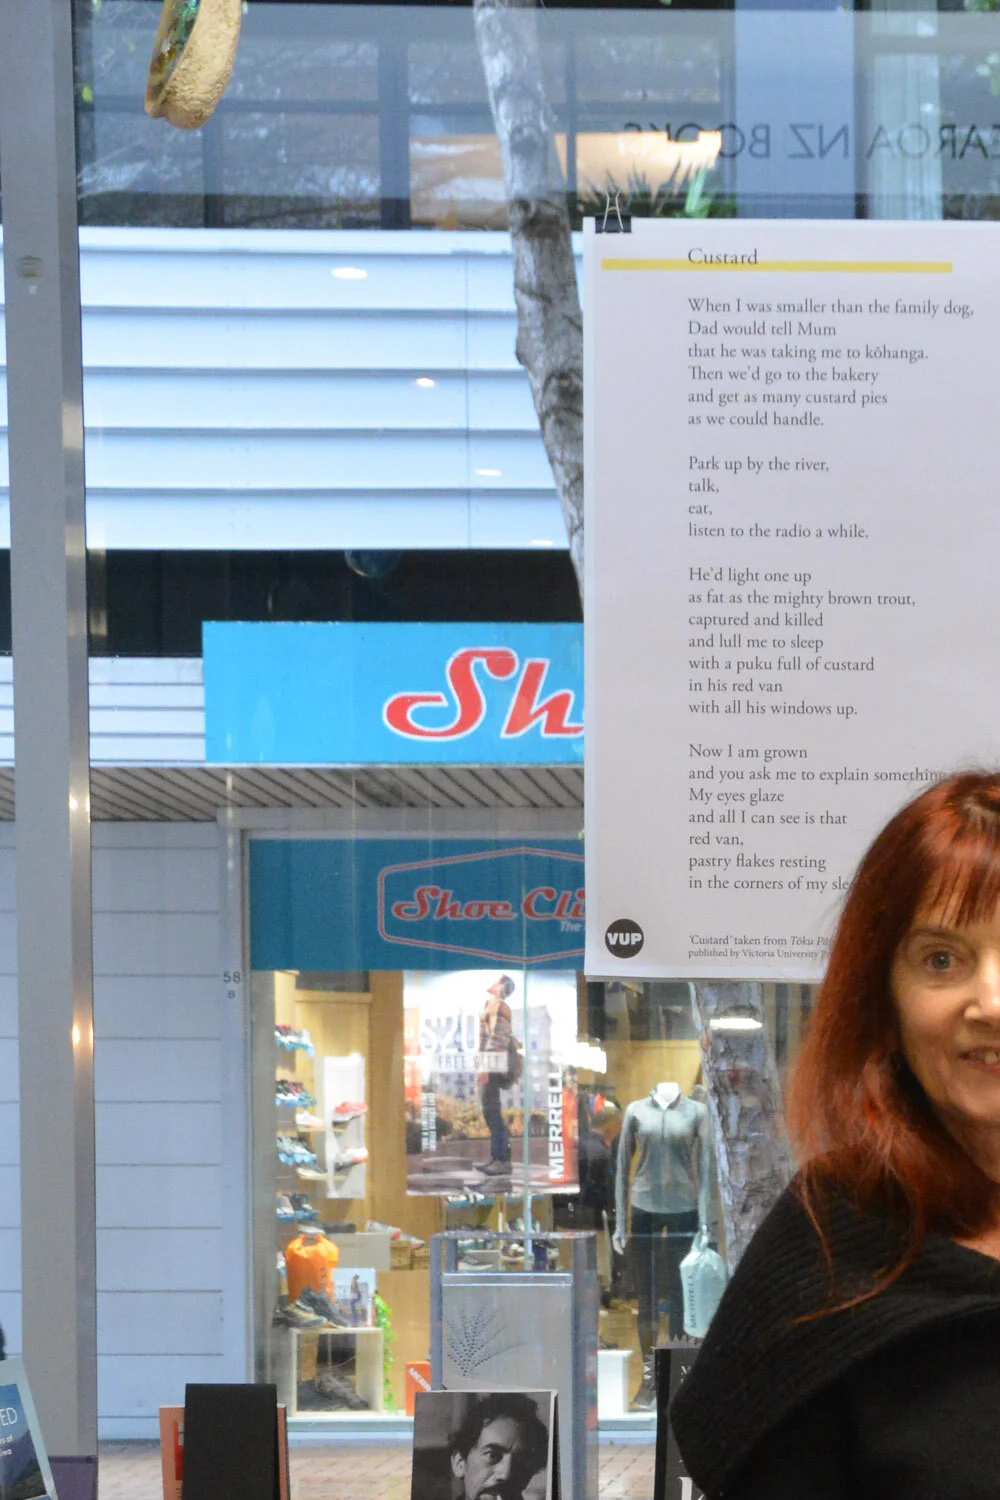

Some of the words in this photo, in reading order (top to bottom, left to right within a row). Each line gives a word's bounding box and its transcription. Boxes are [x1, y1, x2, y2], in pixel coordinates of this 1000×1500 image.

[688, 248, 758, 265] Custard
[687, 297, 731, 313] When
[746, 303, 772, 313] was
[776, 297, 827, 314] smaller
[831, 297, 863, 314] than
[868, 298, 891, 314] the
[895, 298, 940, 319] family
[943, 299, 974, 320] dog,
[688, 319, 718, 336] Dad
[722, 320, 766, 336] would
[771, 320, 793, 336] tell
[797, 321, 837, 337] Mum
[688, 342, 716, 359] that
[720, 343, 737, 358] he
[741, 347, 767, 359] was
[771, 343, 817, 364] taking
[821, 348, 843, 359] me
[846, 348, 861, 359] to
[687, 364, 723, 381] Then
[764, 370, 783, 386] go
[786, 370, 801, 381] to
[805, 366, 828, 381] the
[831, 365, 879, 386] bakery
[687, 387, 714, 403] and
[718, 392, 739, 408] get
[743, 393, 758, 403] as
[762, 393, 802, 408] many
[805, 388, 857, 405] custard
[861, 390, 888, 409] pies
[687, 415, 702, 425] as
[705, 415, 726, 426] we
[729, 410, 769, 426] could
[773, 410, 824, 427] handle.
[688, 455, 720, 471] Park
[724, 460, 743, 475] up
[746, 455, 764, 475] by
[768, 455, 791, 471] the
[795, 457, 830, 473] river,
[688, 477, 720, 494] talk,
[688, 504, 713, 516] eat,
[688, 521, 725, 537] listen
[730, 527, 745, 538] to
[748, 522, 771, 538] the
[775, 522, 812, 538] radio
[815, 528, 823, 538] a
[827, 522, 869, 539] while.
[383, 646, 584, 741] Sh
[688, 743, 723, 758] Now
[737, 748, 760, 759] am
[763, 748, 808, 763] grown
[688, 764, 715, 780] and
[719, 770, 745, 784] you
[748, 765, 772, 780] ask
[775, 770, 797, 781] me
[801, 770, 816, 781] to
[818, 766, 870, 786] explain
[689, 787, 713, 806] My
[716, 792, 746, 806] eyes
[749, 787, 785, 807] glaze
[392, 886, 517, 920] Shoe
[521, 886, 585, 920] Cli
[607, 932, 644, 945] VUP
[734, 936, 760, 945] taken
[763, 935, 787, 945] from
[688, 949, 728, 959] published
[730, 949, 739, 959] by
[742, 949, 775, 958] Victoria
[777, 950, 818, 960] University
[223, 971, 241, 984] 58
